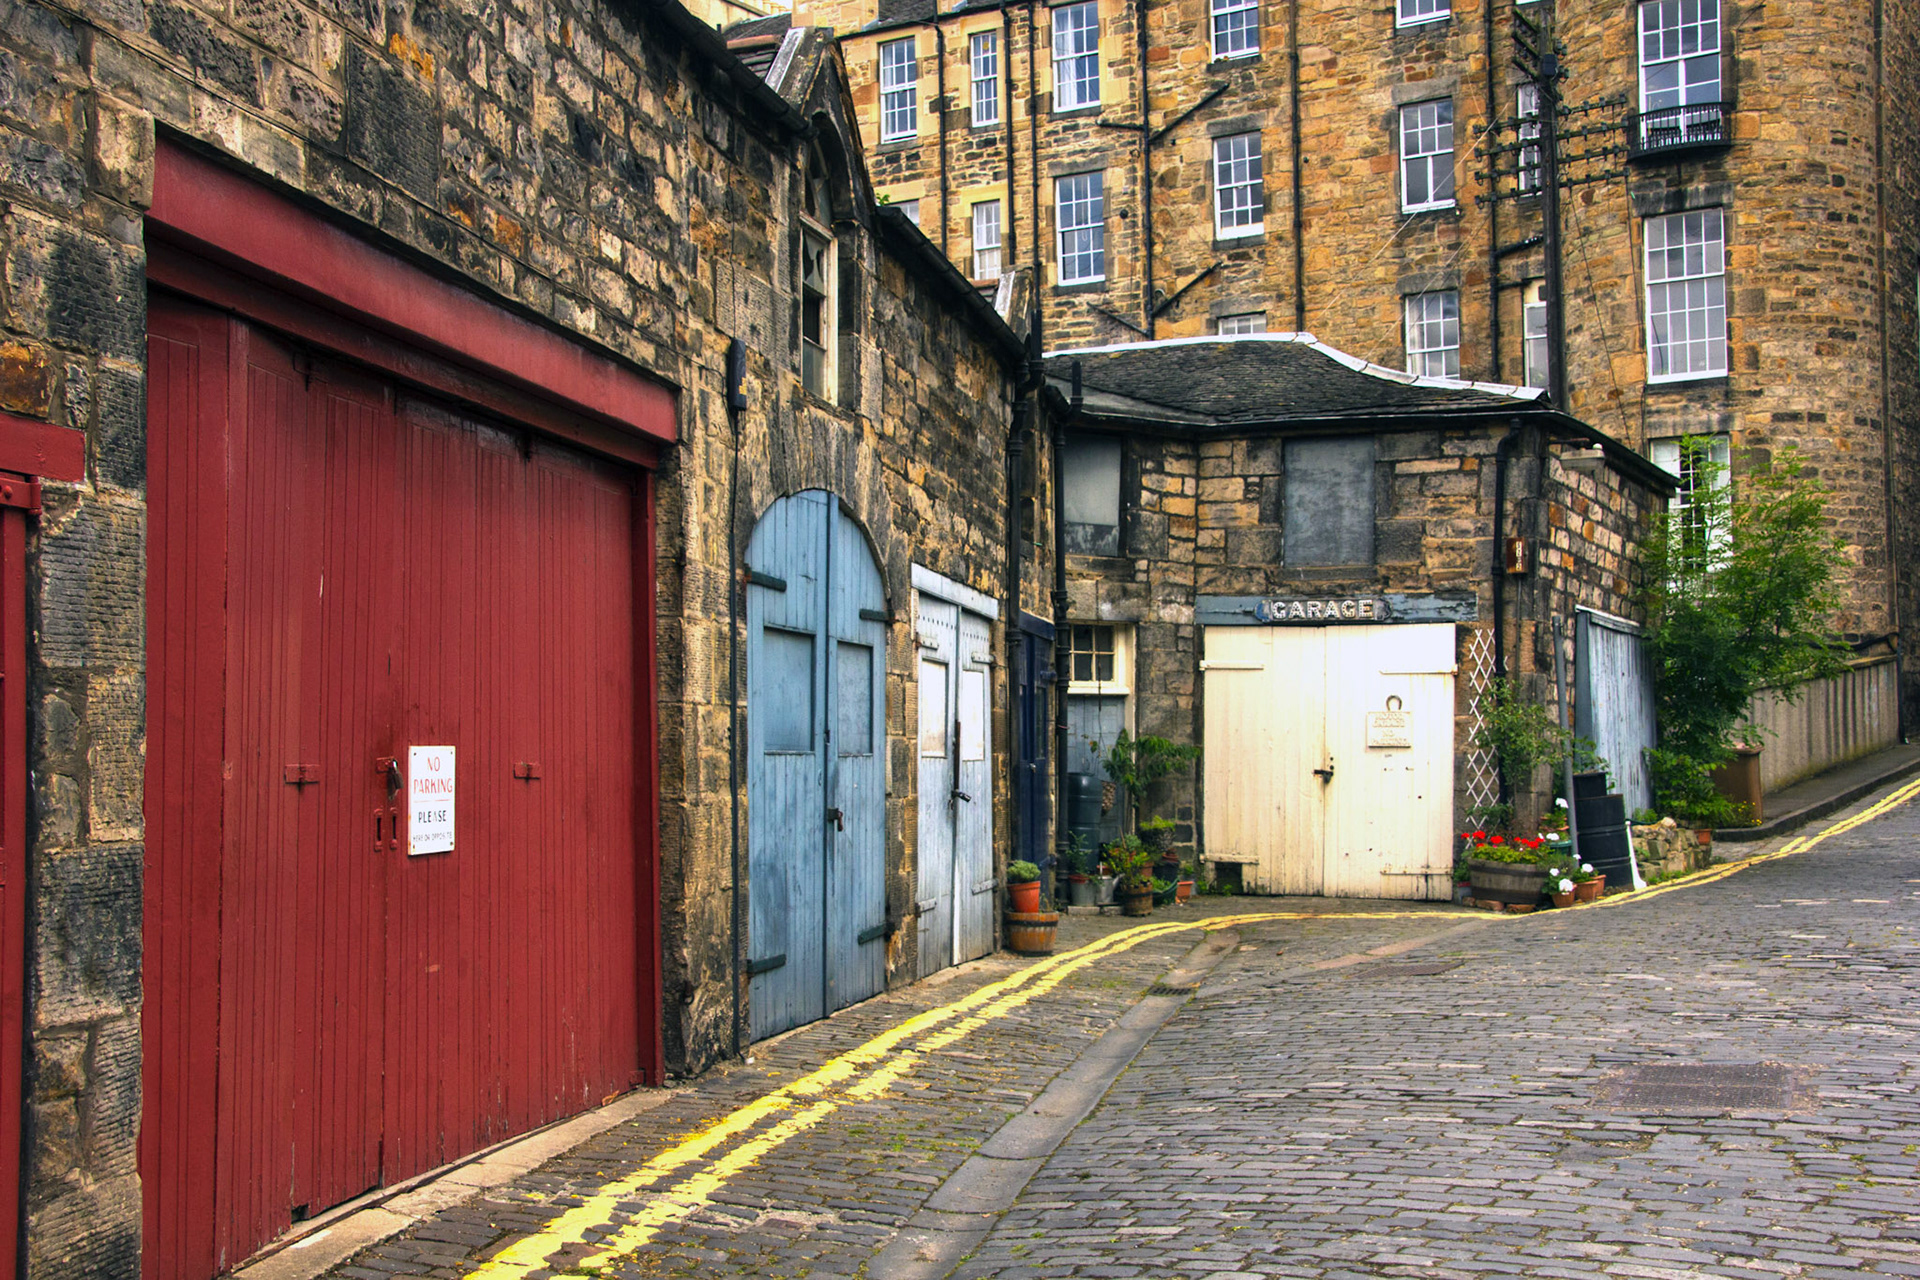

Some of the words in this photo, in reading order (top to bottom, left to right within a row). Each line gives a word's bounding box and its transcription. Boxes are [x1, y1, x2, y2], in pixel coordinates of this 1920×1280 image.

[1271, 600, 1374, 619] GARAGE
[427, 756, 441, 772] NO
[413, 778, 453, 794] PARKING
[418, 810, 447, 824] PLEASE
